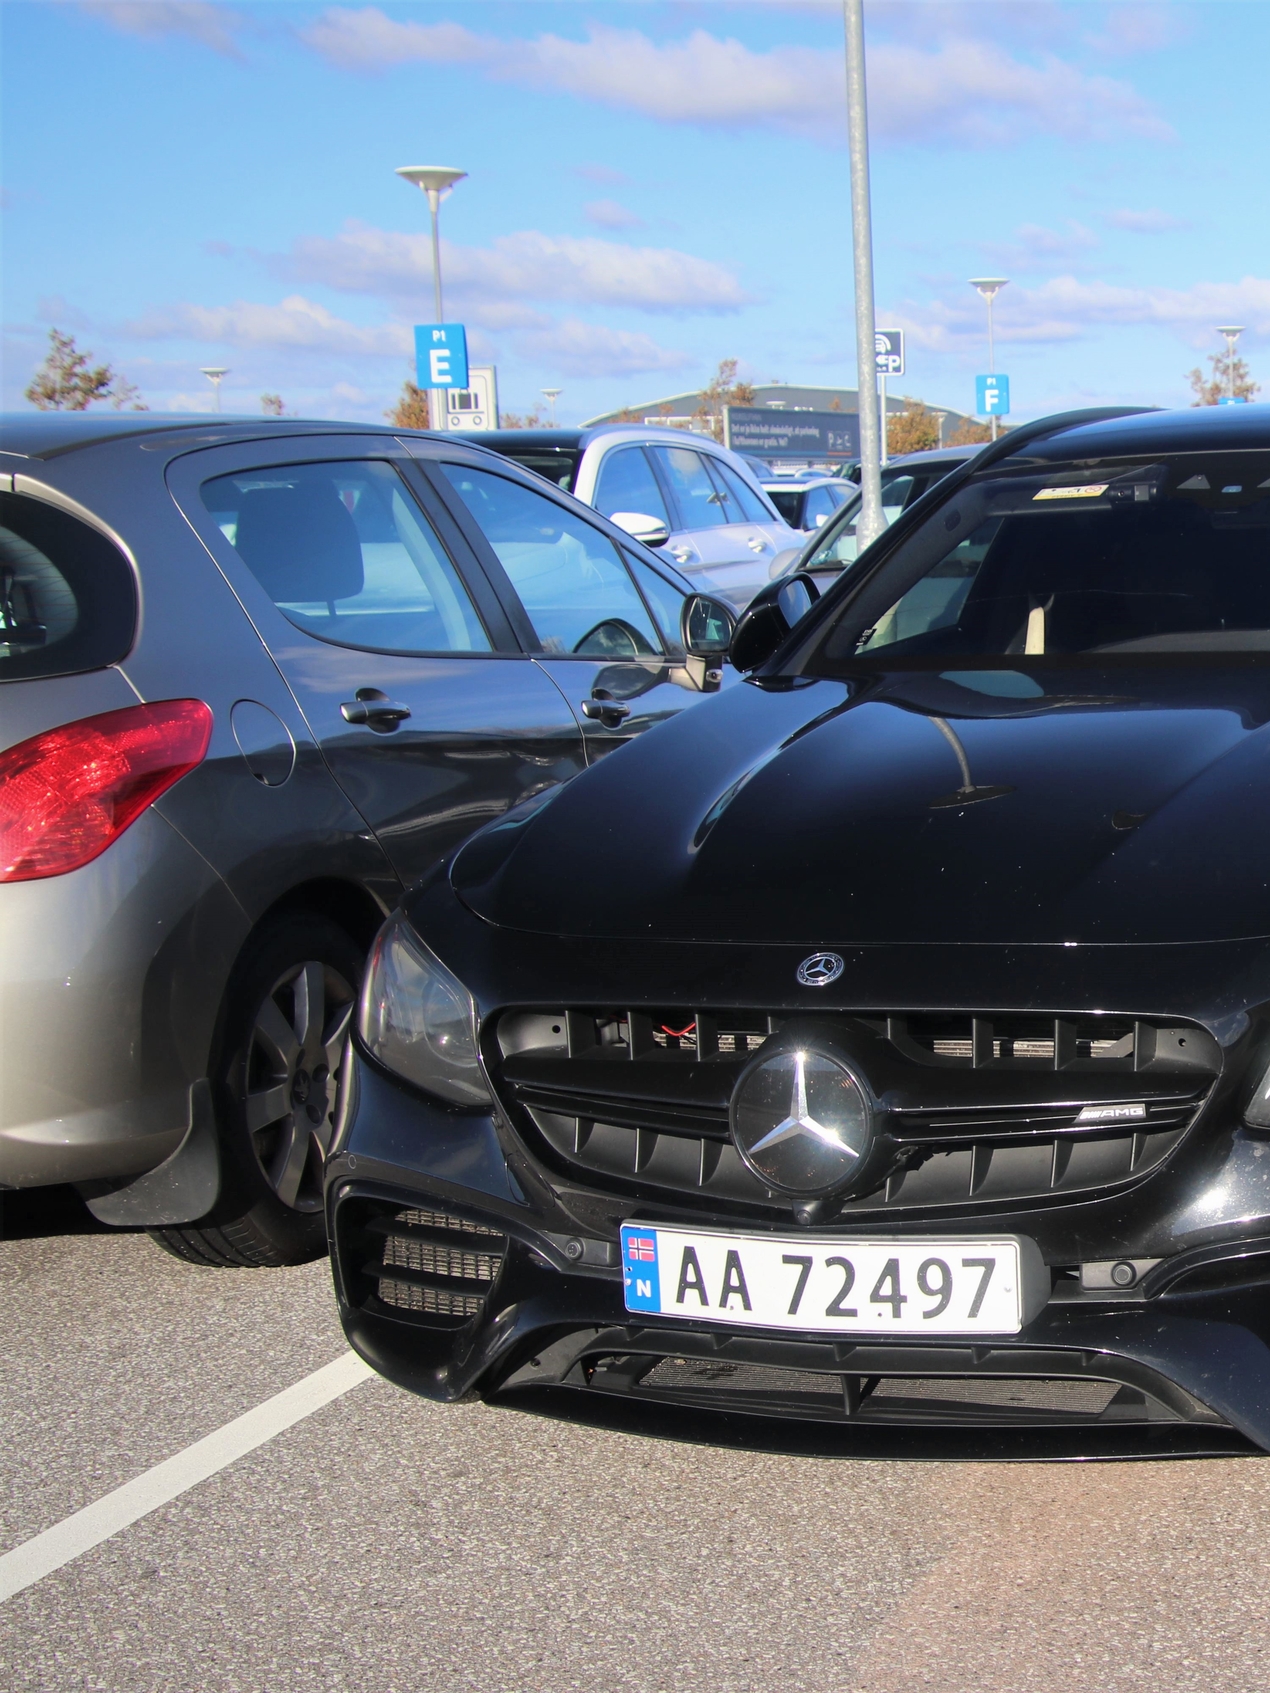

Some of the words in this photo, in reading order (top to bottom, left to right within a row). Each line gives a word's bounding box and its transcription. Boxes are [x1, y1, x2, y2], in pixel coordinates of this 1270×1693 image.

[432, 329, 446, 342] P1
[429, 348, 452, 383] E
[888, 355, 901, 372] P
[985, 389, 999, 412] F
[1100, 1107, 1143, 1117] AMG
[636, 1278, 652, 1299] N
[675, 1245, 753, 1312] AA
[781, 1254, 997, 1320] 72497
